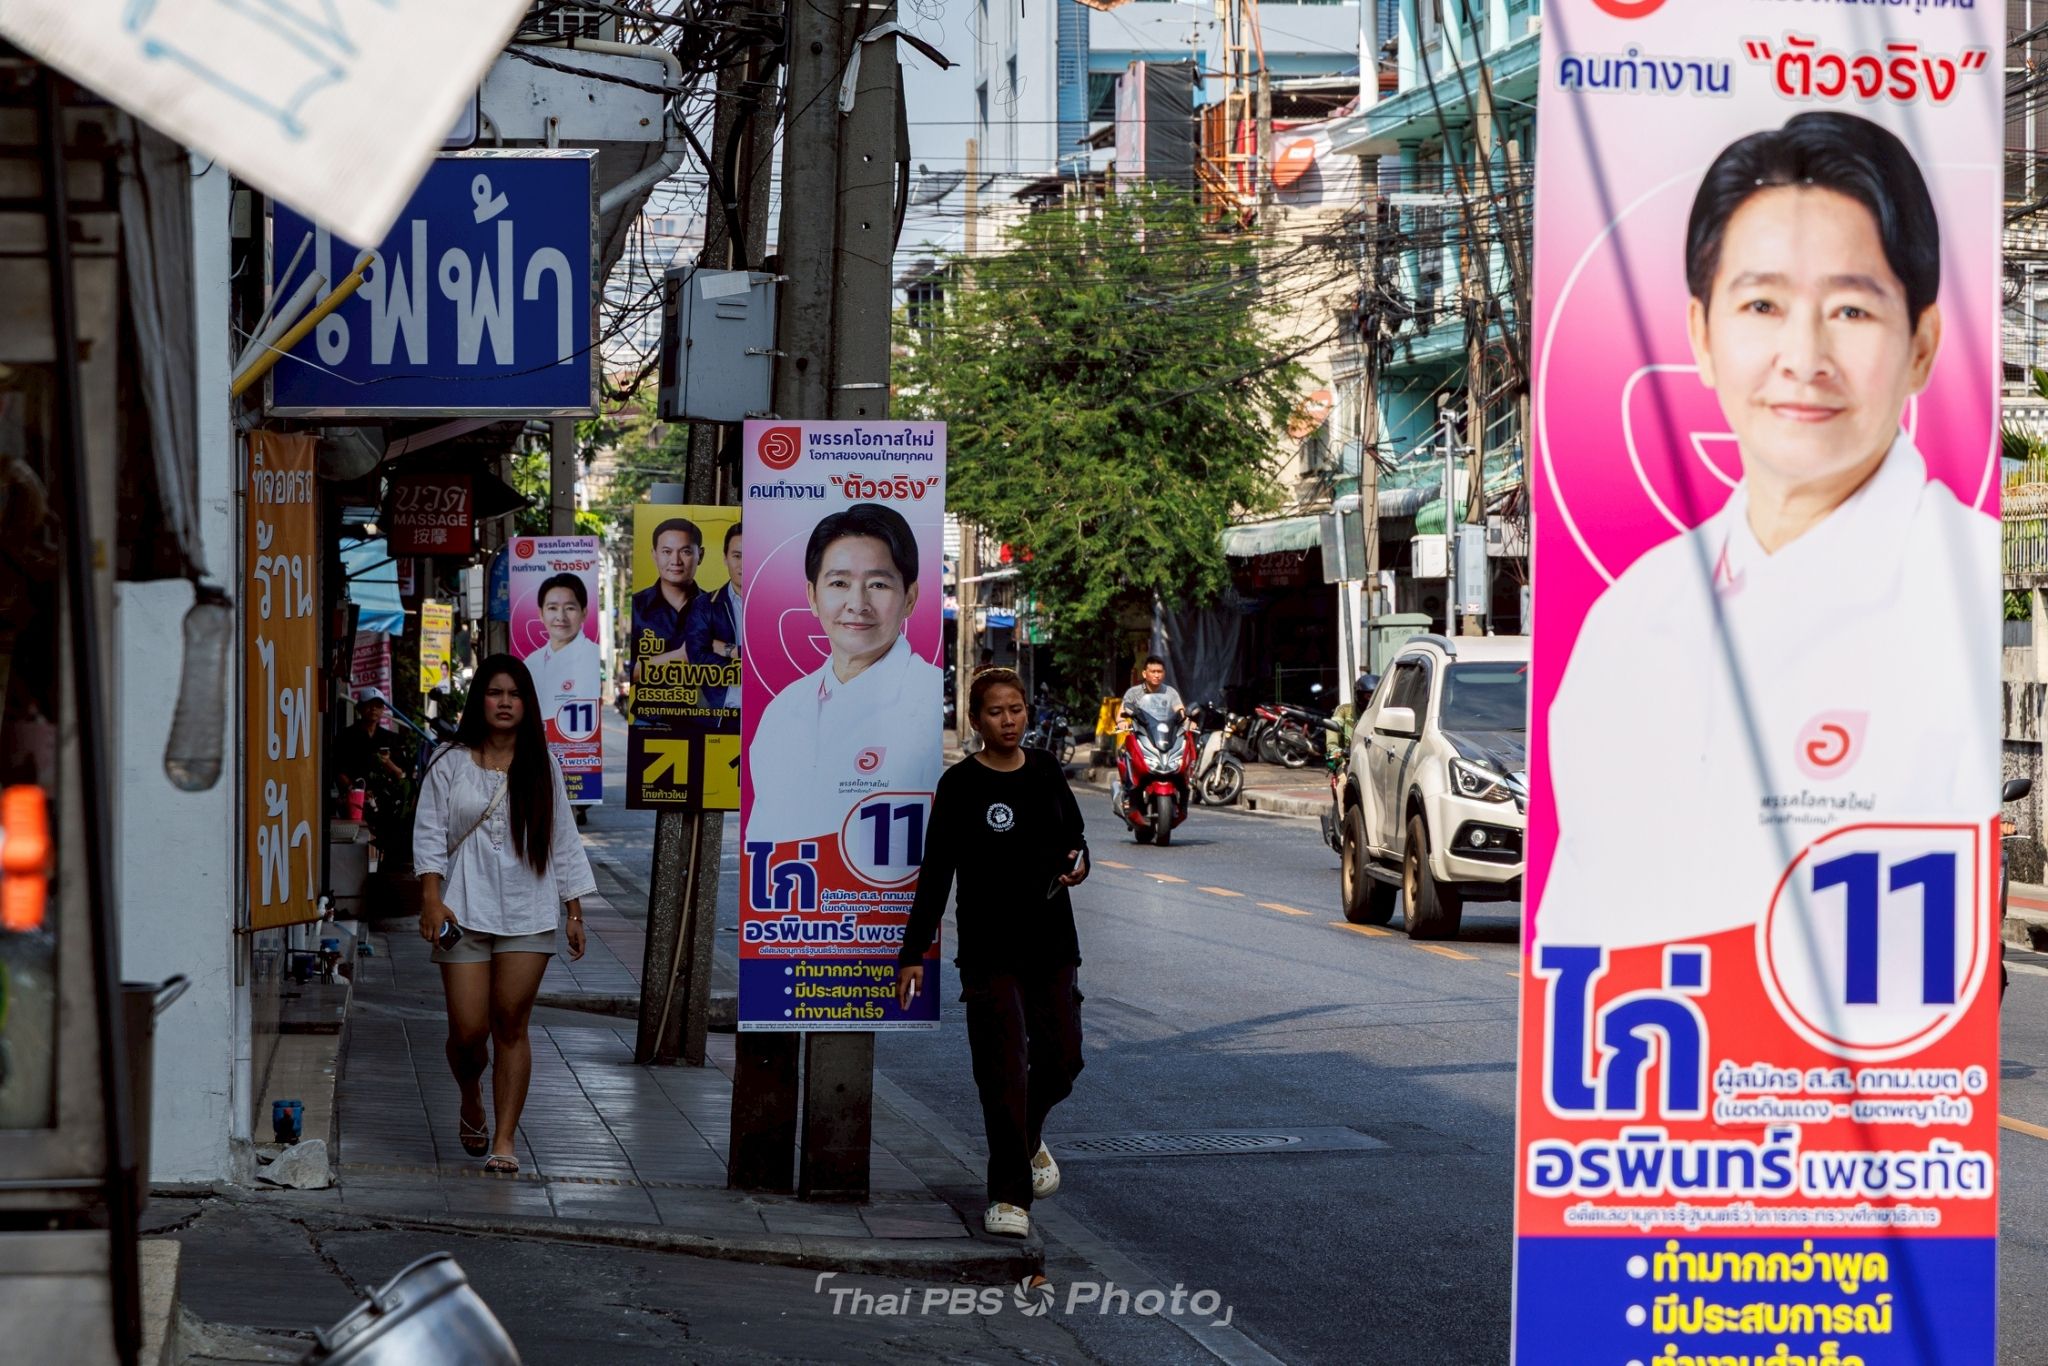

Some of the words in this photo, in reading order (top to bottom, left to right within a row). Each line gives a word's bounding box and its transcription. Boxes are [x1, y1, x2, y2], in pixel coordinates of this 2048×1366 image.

[1559, 49, 1730, 93] คนทำงาน
[809, 428, 934, 447] พรรคโอกาสใหม่
[809, 449, 934, 464] โอกาสของคนไทยทุกคน
[252, 440, 313, 505] ที่จอดรถ
[749, 480, 825, 499] คนทำงาน
[393, 513, 469, 527] MASSAGE
[253, 519, 313, 620] ร้าน
[639, 628, 666, 654] อั้ม
[255, 633, 312, 762] ไฟ
[637, 687, 698, 705] สรรเสริญ
[563, 703, 593, 732] 11
[637, 706, 711, 717] กรุงเทพมหานคร
[713, 707, 730, 717] เขต
[732, 709, 738, 717] 6
[641, 787, 688, 799] ไทยก้าวใหม่
[257, 779, 314, 905] ฟ้า
[860, 803, 924, 866] 11
[744, 841, 819, 912] ไก่
[821, 888, 858, 903] ผู้สมัคร
[745, 916, 856, 942] อรพินทร์
[1812, 851, 1956, 1005] 11
[795, 961, 894, 981] ทำมากกว่าพูด
[795, 982, 897, 998] มีประสบการณ์
[795, 1002, 885, 1019] ทำงานสำเร็จ
[1539, 945, 1702, 1112] ไก่
[1716, 1064, 1799, 1100] ผู้สมัคร
[1859, 1067, 1958, 1091] กทม.เขต
[1965, 1069, 1983, 1090] 6
[1534, 1130, 1795, 1189] อรพินทร์
[1805, 1145, 1988, 1191] เพชรทัต
[1652, 1239, 1889, 1294] ทำมากกว่าพูด
[1652, 1293, 1893, 1333] มีประสบการณ์
